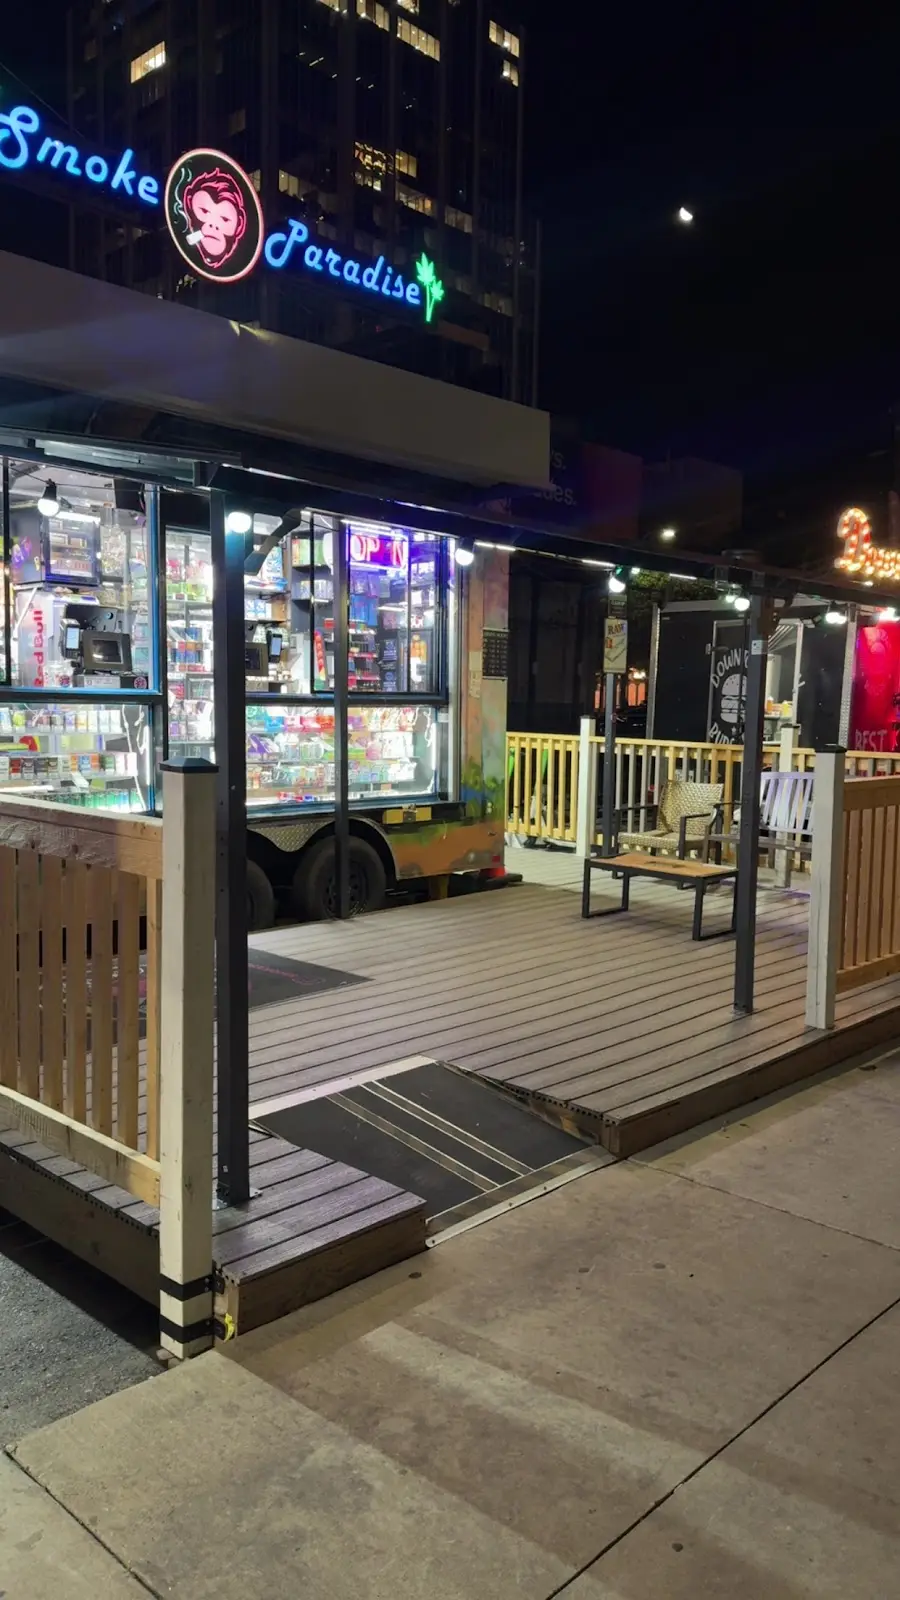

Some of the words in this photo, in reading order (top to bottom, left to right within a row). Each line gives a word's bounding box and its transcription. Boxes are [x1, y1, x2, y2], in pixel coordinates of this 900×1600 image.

[0, 105, 158, 205] Smoke
[264, 218, 420, 305] Paradise
[33, 610, 44, 648] Bull
[711, 648, 741, 689] DOWN
